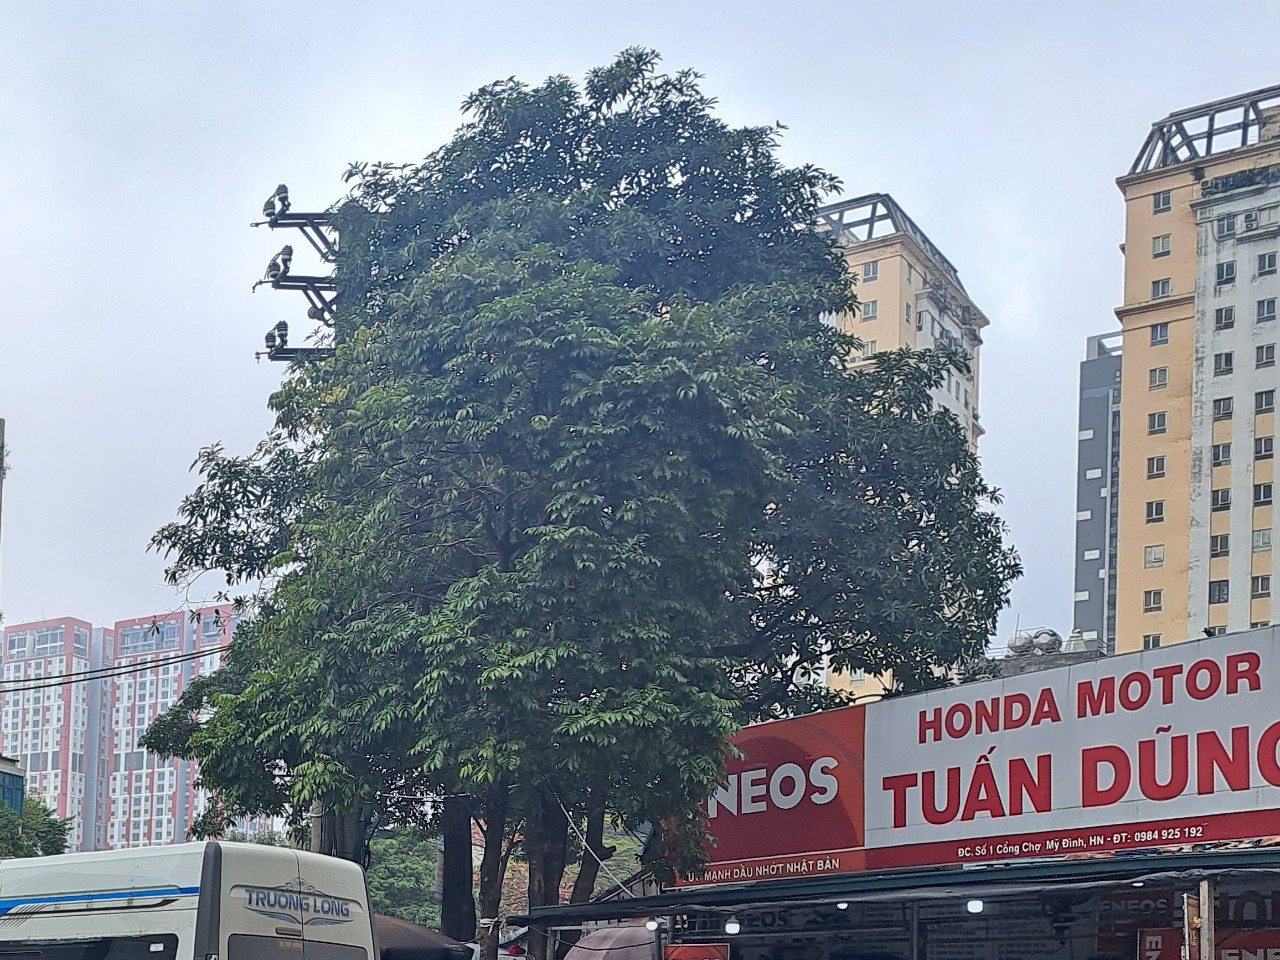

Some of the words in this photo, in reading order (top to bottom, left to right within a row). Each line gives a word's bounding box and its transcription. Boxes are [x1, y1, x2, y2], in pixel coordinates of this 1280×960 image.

[918, 687, 1061, 745] HONDA
[1077, 651, 1262, 720] MOTOR
[707, 756, 839, 819] NEOS
[882, 745, 1052, 829] TUẤN
[975, 843, 987, 855] Số
[996, 843, 1020, 856] Cổng
[1022, 841, 1042, 853] Chợ
[1046, 838, 1060, 850] Mỹ
[1089, 835, 1104, 845] HN
[1134, 830, 1159, 842] 0984
[1161, 829, 1181, 839] 925
[1184, 826, 1204, 837] 192
[705, 871, 731, 882] MẠNH
[733, 864, 753, 878] DẦU
[756, 861, 784, 876] NHỚT
[787, 859, 815, 874] NHẬT
[817, 856, 840, 870] BẢN
[313, 898, 350, 917] LONG
